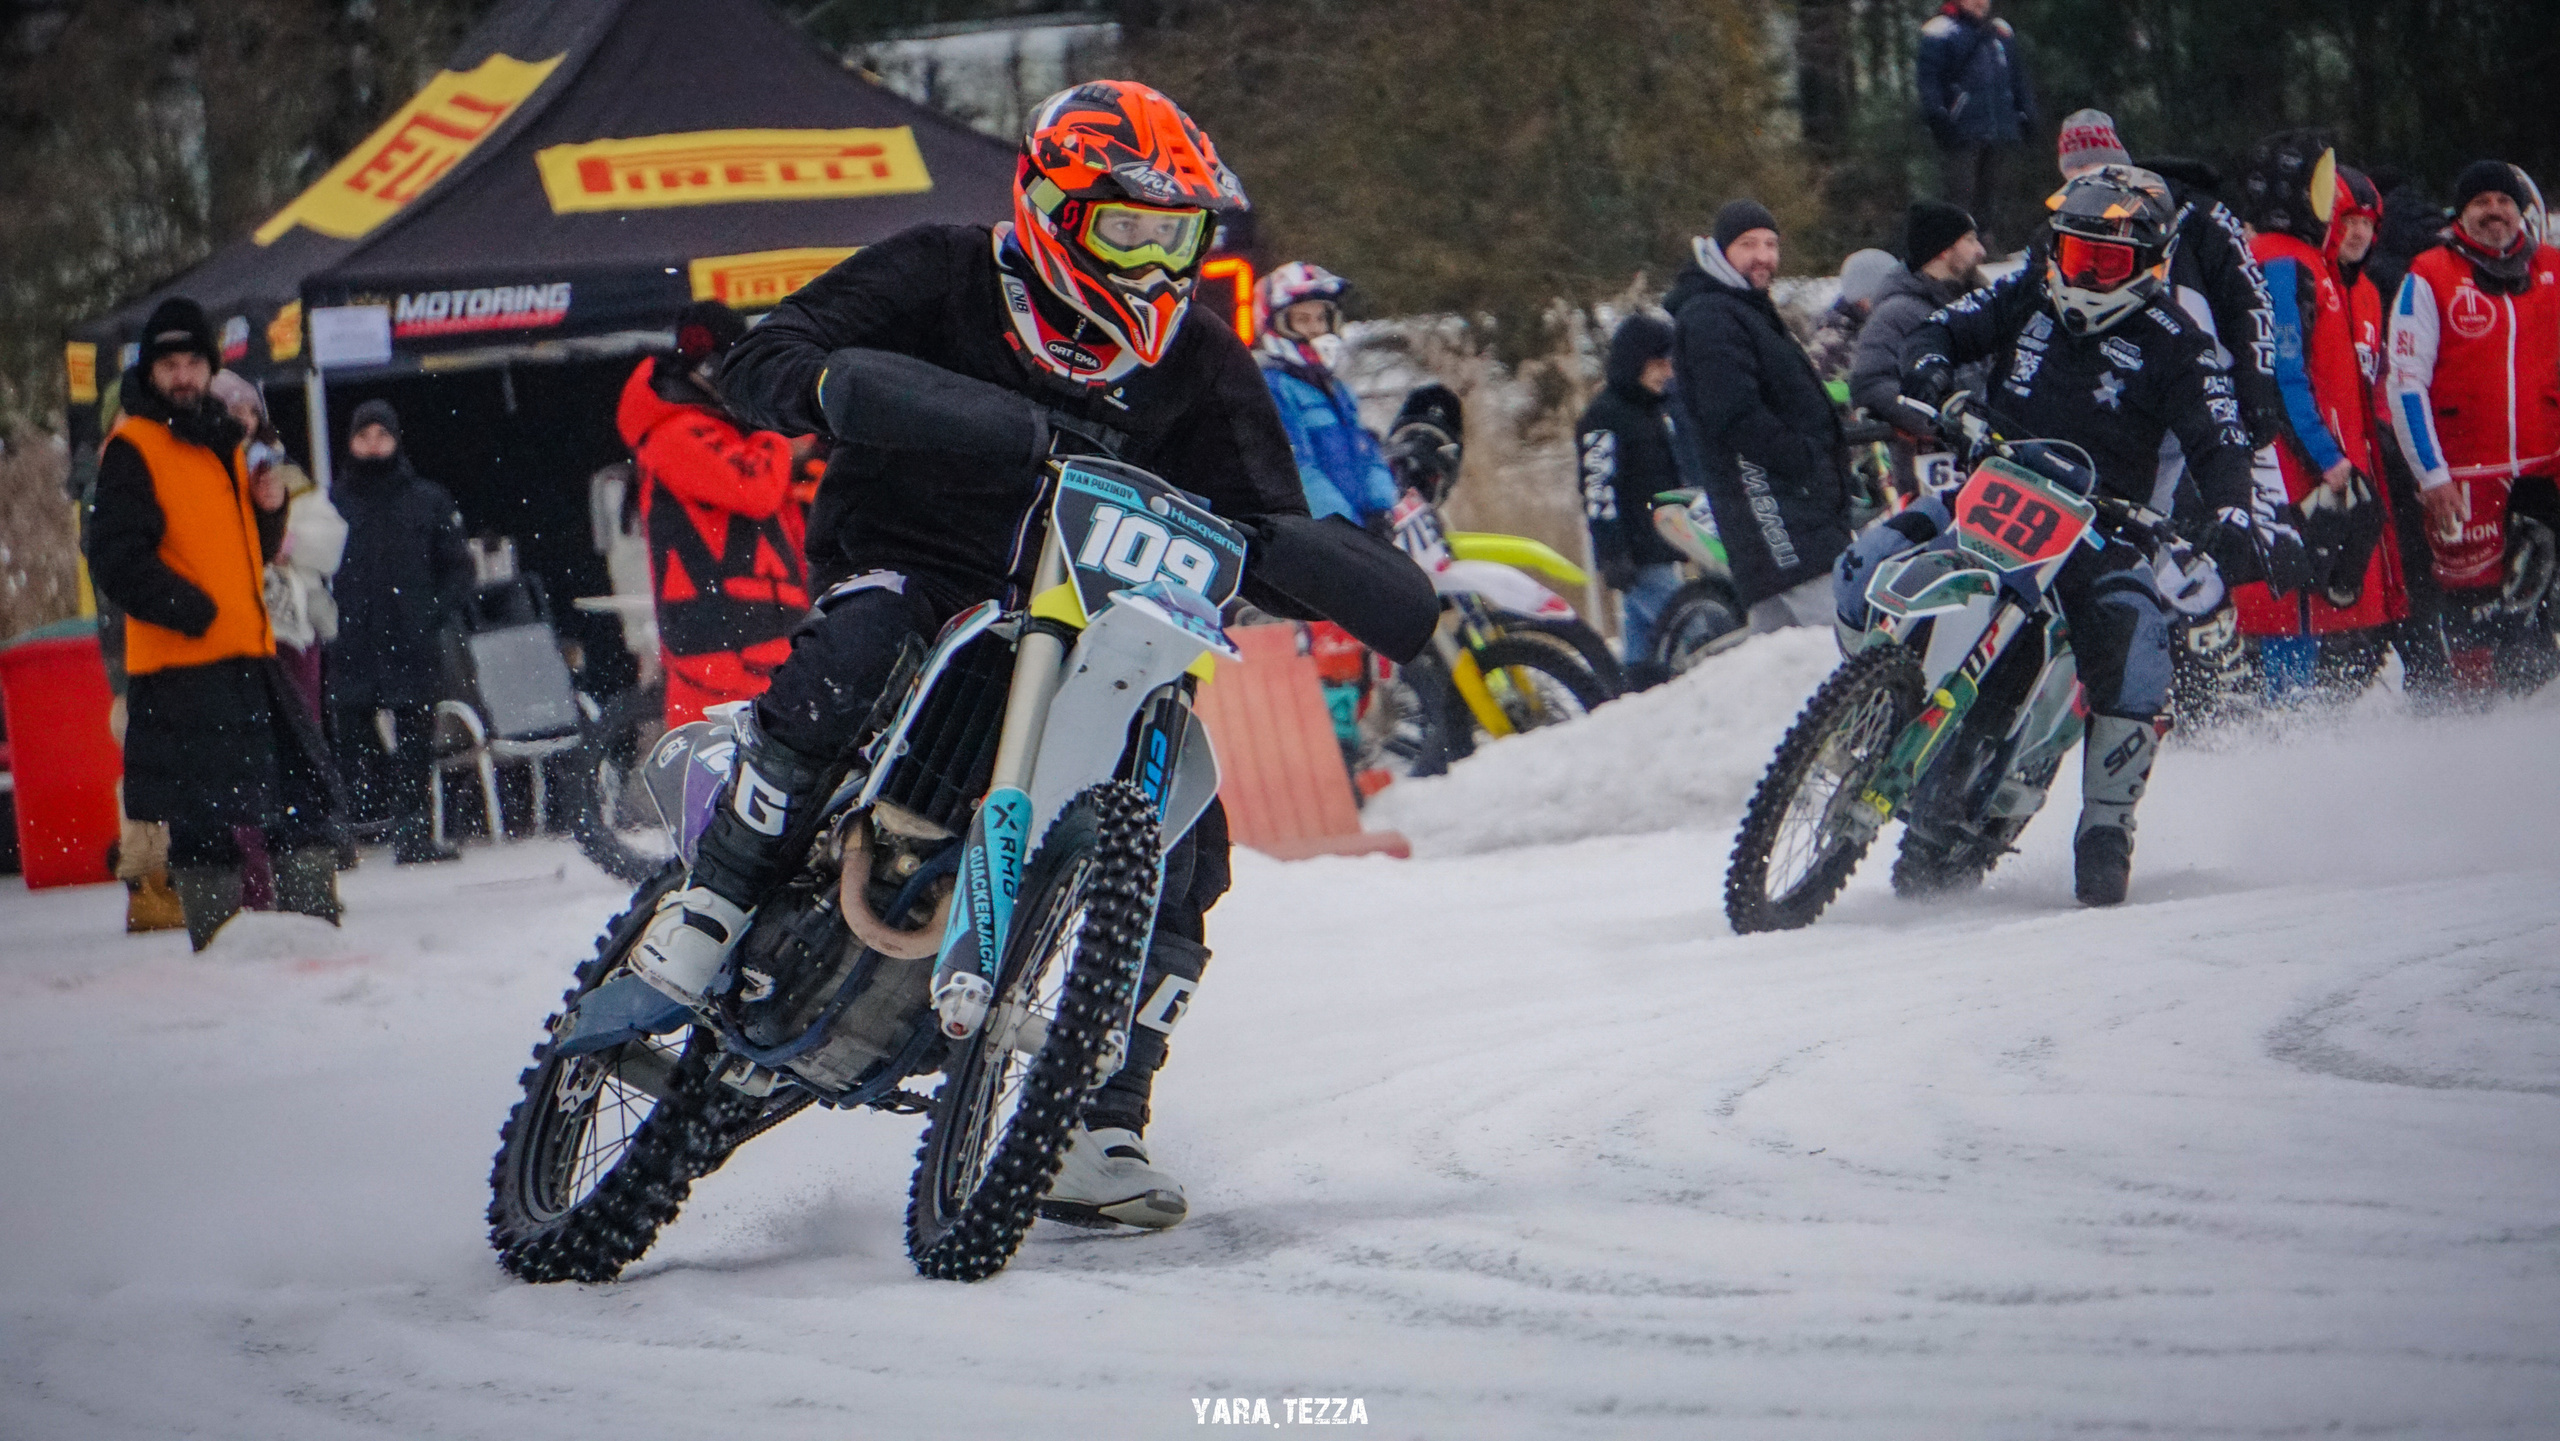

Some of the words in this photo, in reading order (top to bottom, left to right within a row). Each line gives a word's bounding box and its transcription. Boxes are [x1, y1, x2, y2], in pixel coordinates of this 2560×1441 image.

[577, 144, 889, 193] PIRELLI
[396, 283, 571, 323] MOTORING
[1065, 471, 1090, 487] IVAN
[1091, 476, 1134, 500] PUZIKOV
[1170, 507, 1243, 557] Husqvarna
[1966, 480, 2061, 557] 29
[1077, 503, 1219, 595] 109
[999, 836, 1018, 899] RMG
[969, 845, 994, 976] QUACKERJACK
